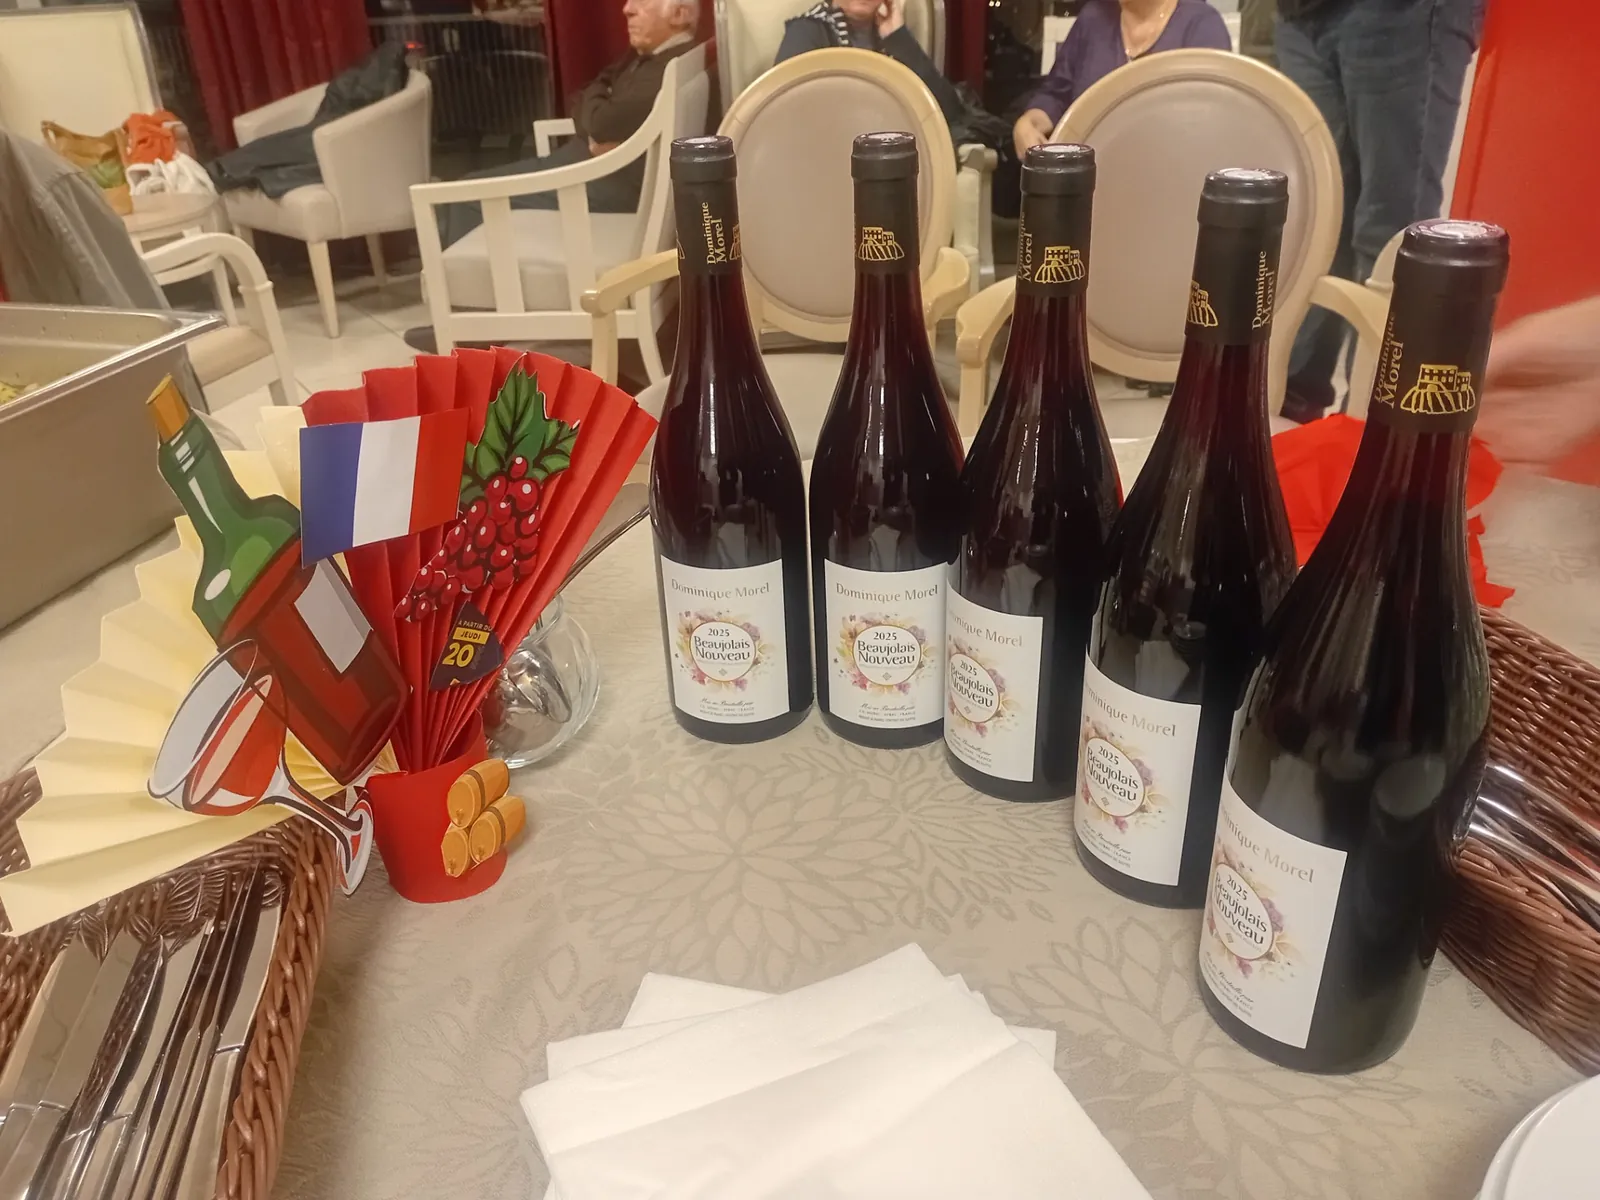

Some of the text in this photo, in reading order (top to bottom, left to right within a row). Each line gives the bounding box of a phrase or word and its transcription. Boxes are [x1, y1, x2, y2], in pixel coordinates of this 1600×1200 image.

[702, 202, 716, 264] Dominique
[711, 218, 727, 263] Morel
[1023, 232, 1032, 282] Morel
[1252, 251, 1268, 330] Dominique
[1262, 271, 1275, 327] Morel
[1381, 340, 1404, 409] Morel
[671, 579, 770, 601] Dominique Morel
[836, 582, 938, 603] Dominique Morel
[460, 630, 481, 640] JEUDI
[463, 620, 483, 629] PARTIR
[708, 628, 730, 637] 2025
[873, 631, 897, 641] 2025
[693, 635, 750, 652] Beaujolais
[857, 640, 916, 657] Beaujolais
[985, 628, 1023, 647] Morel
[442, 642, 474, 667] 20
[695, 646, 750, 661] Nouveau
[858, 651, 915, 665] Nouveau
[951, 662, 994, 696] Beaujolais
[960, 660, 977, 676] 2025
[951, 674, 993, 707] Nouveau
[1131, 714, 1176, 737] Morel
[1087, 747, 1139, 789] Beaujolais
[1098, 746, 1119, 765] 2025
[1087, 760, 1137, 801] Nouveau
[1264, 847, 1315, 883] Morel
[1227, 874, 1248, 900] 2025
[1215, 872, 1267, 933] Beaujolais
[1214, 889, 1264, 945] Nouveau
